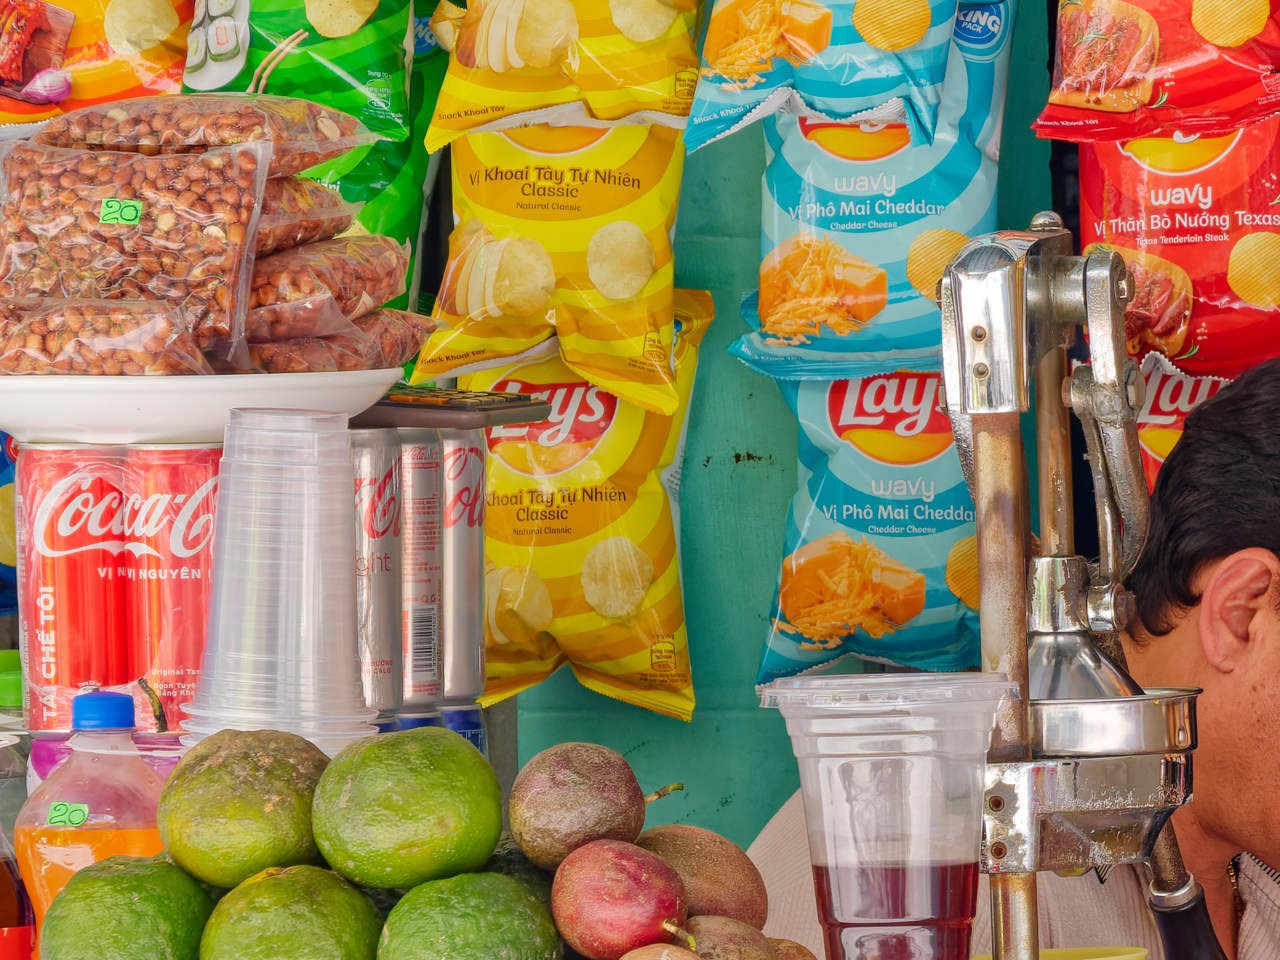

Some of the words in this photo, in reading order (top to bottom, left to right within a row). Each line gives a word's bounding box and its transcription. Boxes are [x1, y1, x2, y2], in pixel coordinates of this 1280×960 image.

[962, 21, 983, 33] PACK
[438, 111, 462, 121] Snack
[464, 107, 489, 118] Khoai
[469, 171, 480, 187] Vị
[484, 166, 529, 182] Khoai
[535, 166, 564, 184] Tây
[570, 167, 589, 184] Tự
[594, 169, 641, 189] Nhiên
[834, 172, 896, 197] wavy
[520, 182, 580, 199] Classic
[1151, 184, 1212, 208] wavy
[101, 200, 140, 224] 20
[516, 201, 549, 211] Natural
[551, 202, 582, 212] Classic
[807, 201, 836, 219] Phô
[840, 200, 871, 216] Mai
[875, 199, 945, 217] Cheddar
[830, 221, 867, 231] Cheddar
[868, 220, 898, 230] Cheese
[1094, 221, 1106, 239] Vị
[1110, 216, 1145, 232] Thăn
[1150, 213, 1171, 229] Bò
[1175, 211, 1230, 231] Nướng
[1136, 237, 1157, 246] Texas
[1159, 234, 1202, 245] Tenderloin
[1204, 233, 1230, 243] Steak
[490, 380, 606, 446] Ly's
[839, 377, 947, 436] Lay
[528, 489, 555, 508] Tây
[560, 488, 577, 505] Tự
[582, 487, 627, 502] Nhiên
[871, 477, 936, 502] wavy
[516, 507, 569, 522] Classic
[822, 506, 838, 524] Vị
[842, 503, 873, 520] Phô
[878, 503, 909, 520] Mai
[512, 526, 542, 536] Natural
[868, 525, 904, 535] Cheddar
[906, 524, 937, 535] Cheese
[139, 566, 201, 579] NGUYÊN
[355, 552, 391, 576] ght
[36, 586, 55, 625] TÔI
[185, 668, 200, 676] Tas
[49, 803, 87, 826] 20
